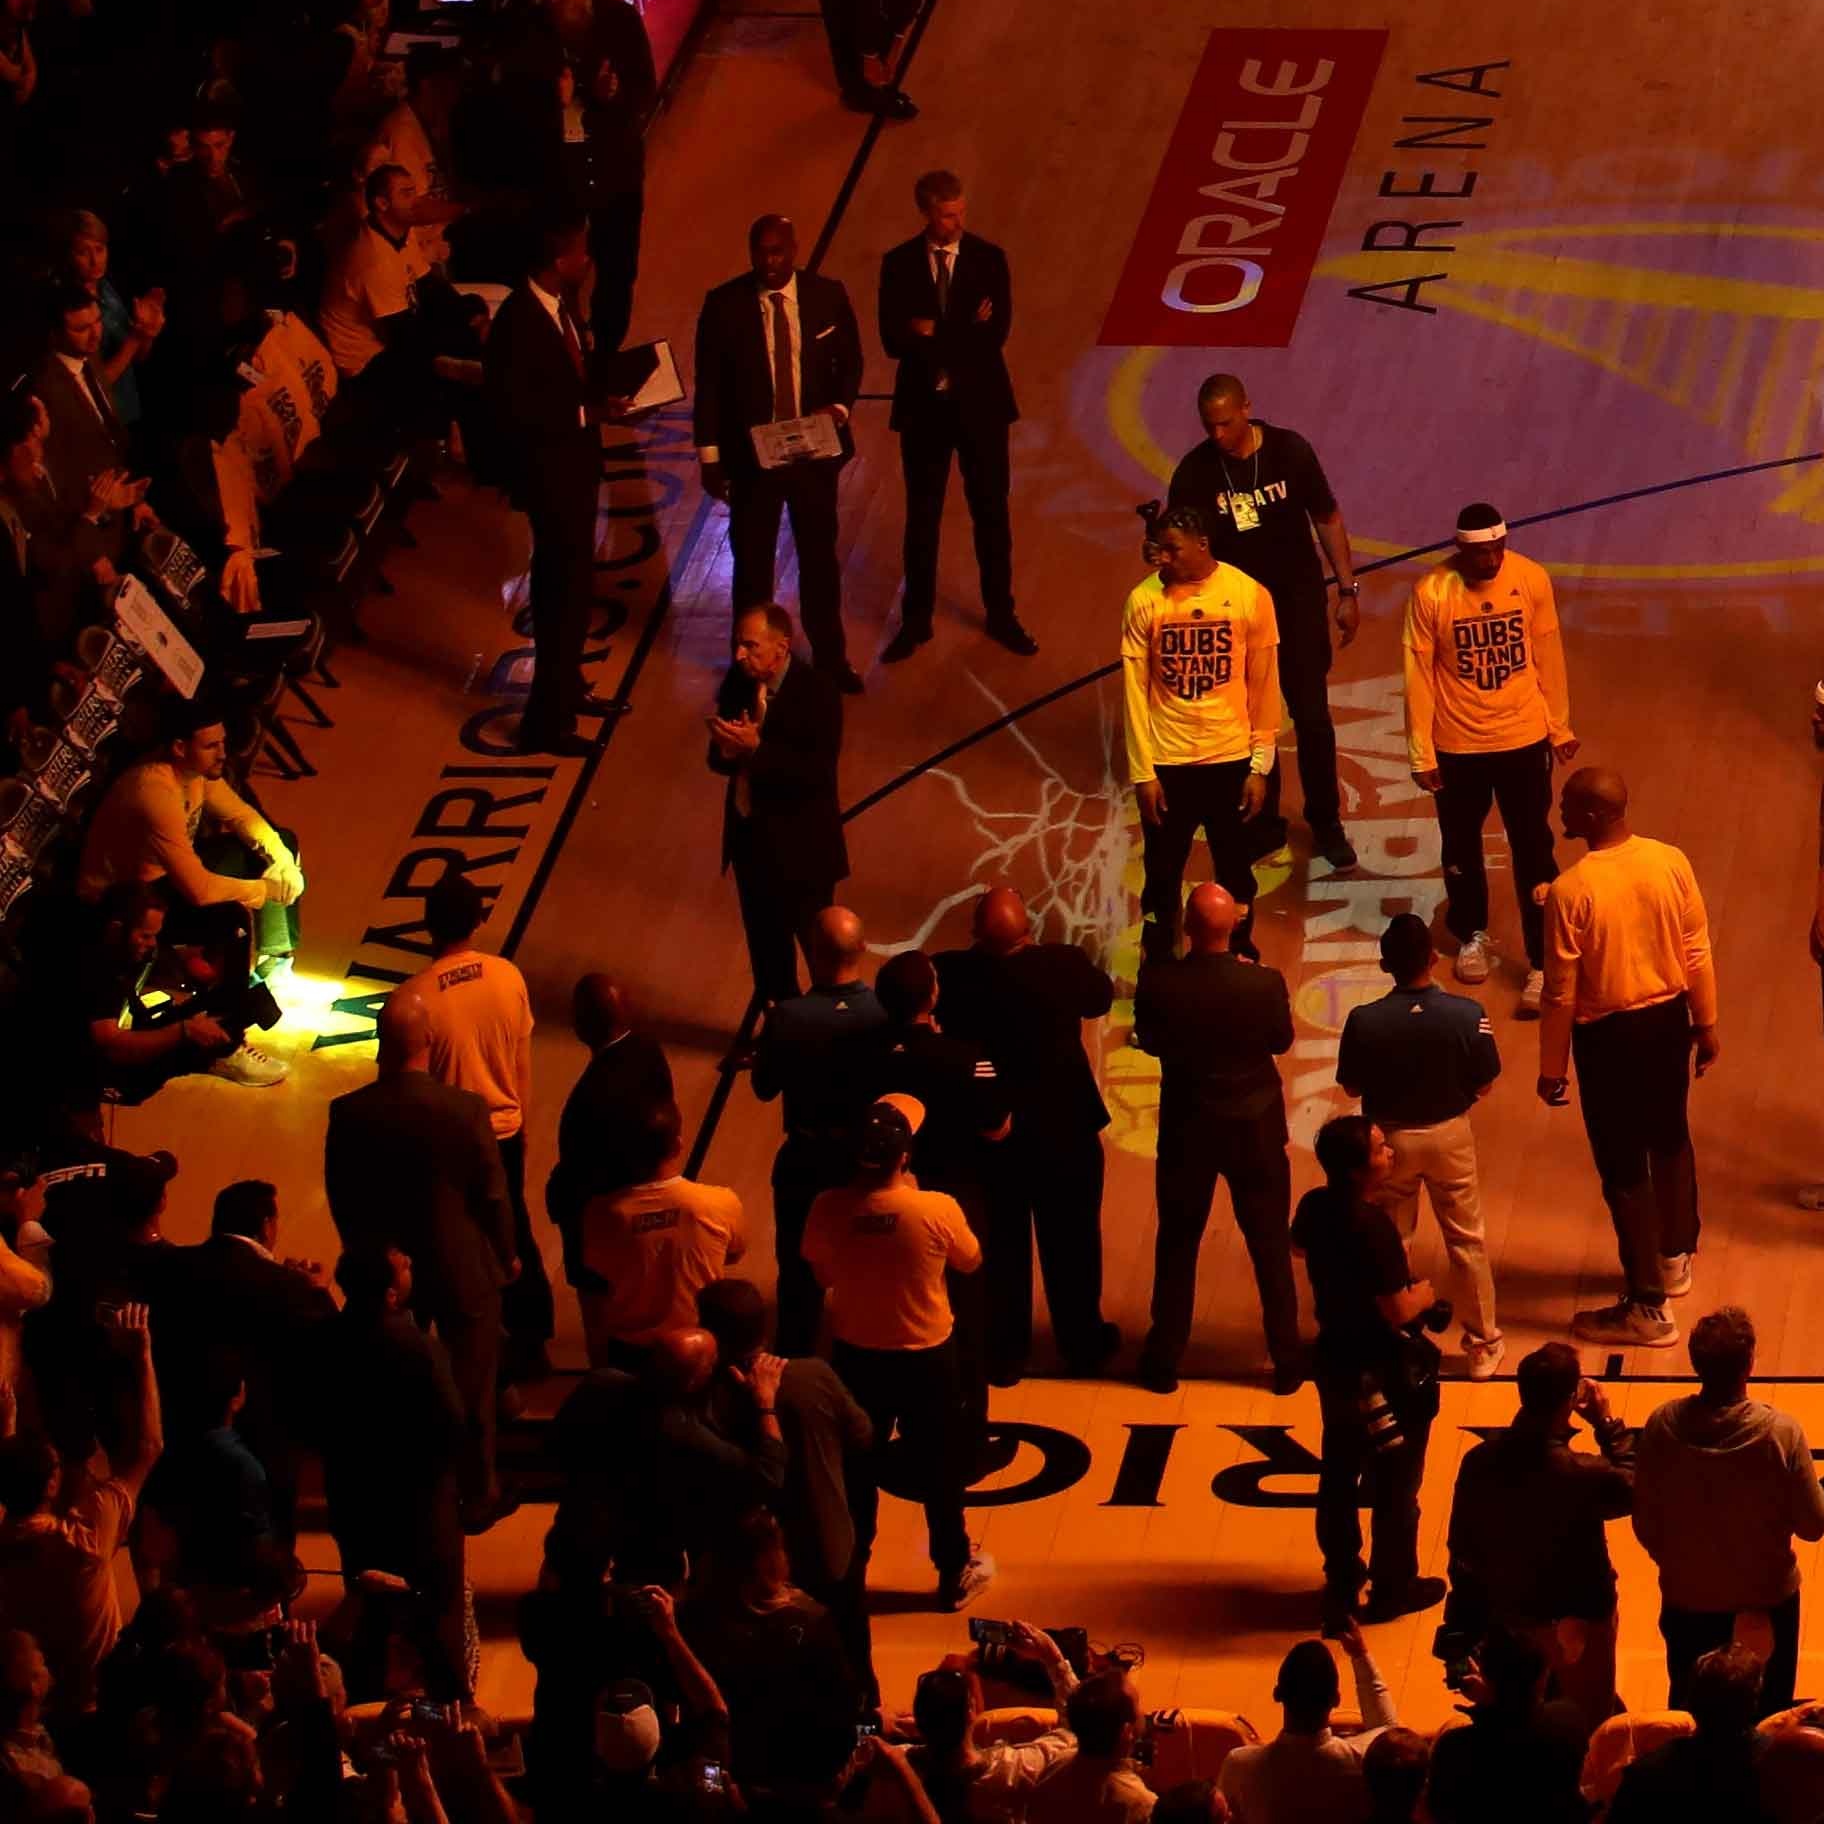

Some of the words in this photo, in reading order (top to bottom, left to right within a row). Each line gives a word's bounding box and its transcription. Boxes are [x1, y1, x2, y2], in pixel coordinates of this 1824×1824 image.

[1160, 58, 1336, 313] ORACLE
[1347, 60, 1511, 314] ARENA
[1161, 626, 1233, 656] DUBS
[1454, 616, 1524, 651] DUBS
[1161, 655, 1233, 685] STAND
[1456, 643, 1525, 676] STAND
[1177, 676, 1213, 700] UP
[1475, 666, 1510, 691] UP
